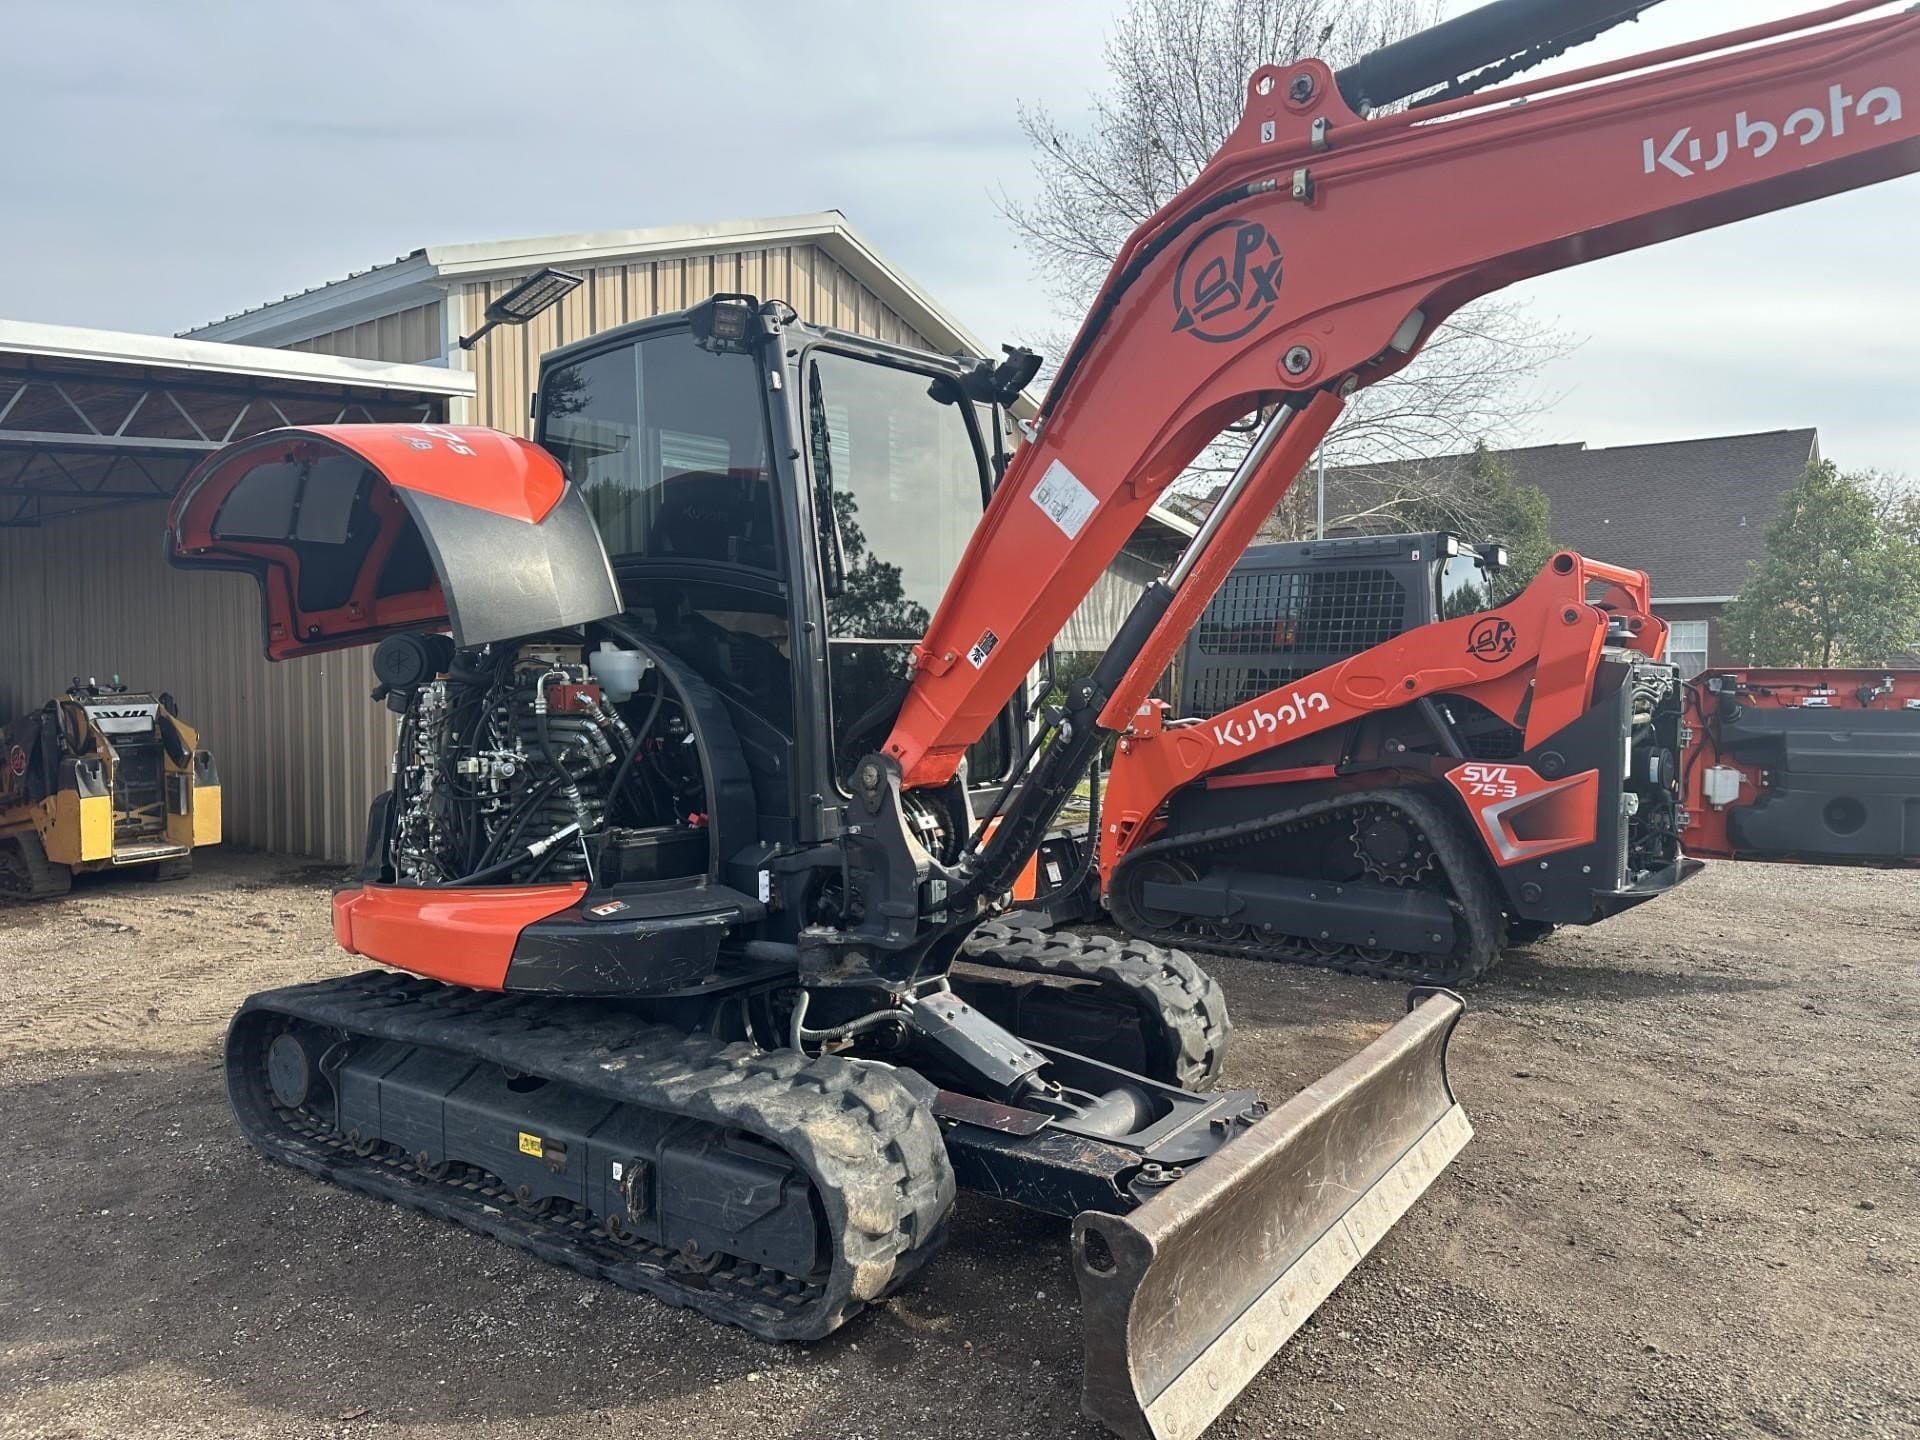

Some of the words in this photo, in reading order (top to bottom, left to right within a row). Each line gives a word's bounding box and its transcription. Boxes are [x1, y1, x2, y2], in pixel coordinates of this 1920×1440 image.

[1642, 84, 1903, 178] Kubota
[1213, 691, 1330, 746] Kubota
[1461, 766, 1516, 784] SVL
[1470, 782, 1518, 798] 75-3
